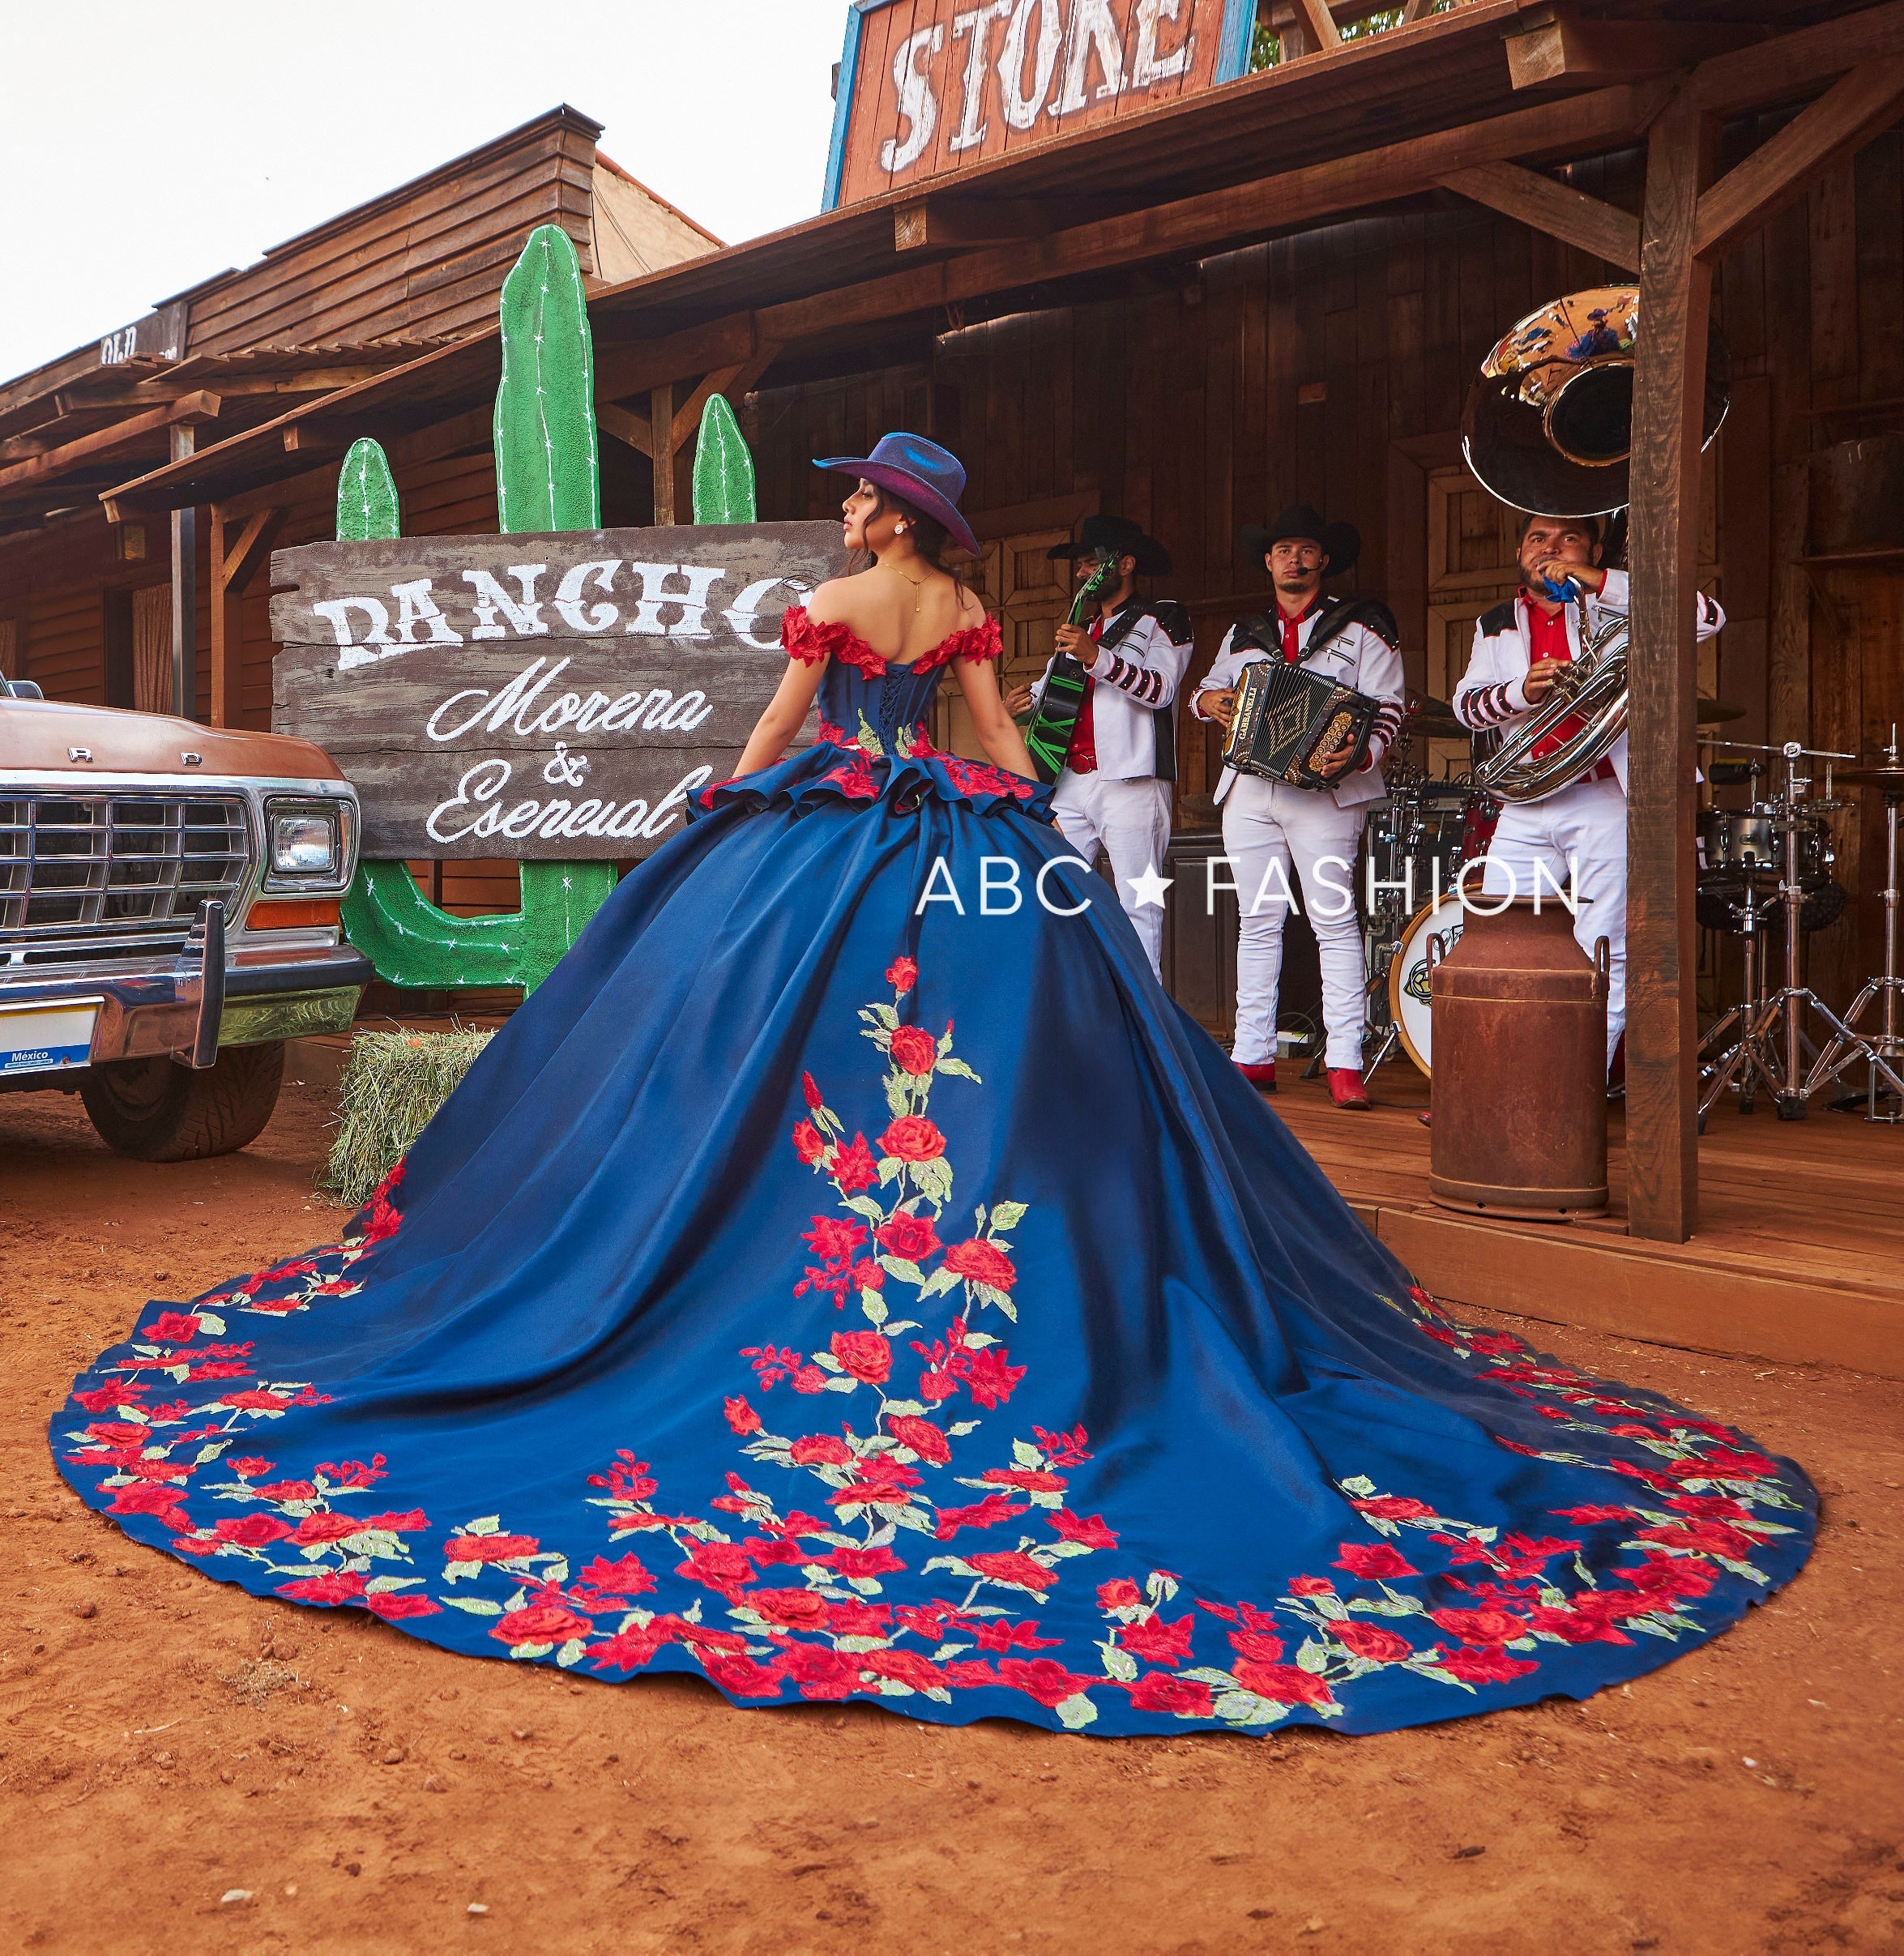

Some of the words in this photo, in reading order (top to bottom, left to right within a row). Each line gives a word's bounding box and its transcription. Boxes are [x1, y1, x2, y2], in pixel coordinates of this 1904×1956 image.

[881, 0, 1196, 172] STORE
[314, 559, 814, 670] RANCHO
[426, 657, 714, 741] Morena
[1239, 686, 1257, 740] GABBANELLI
[544, 741, 591, 787] &
[11, 1050, 49, 1061] México
